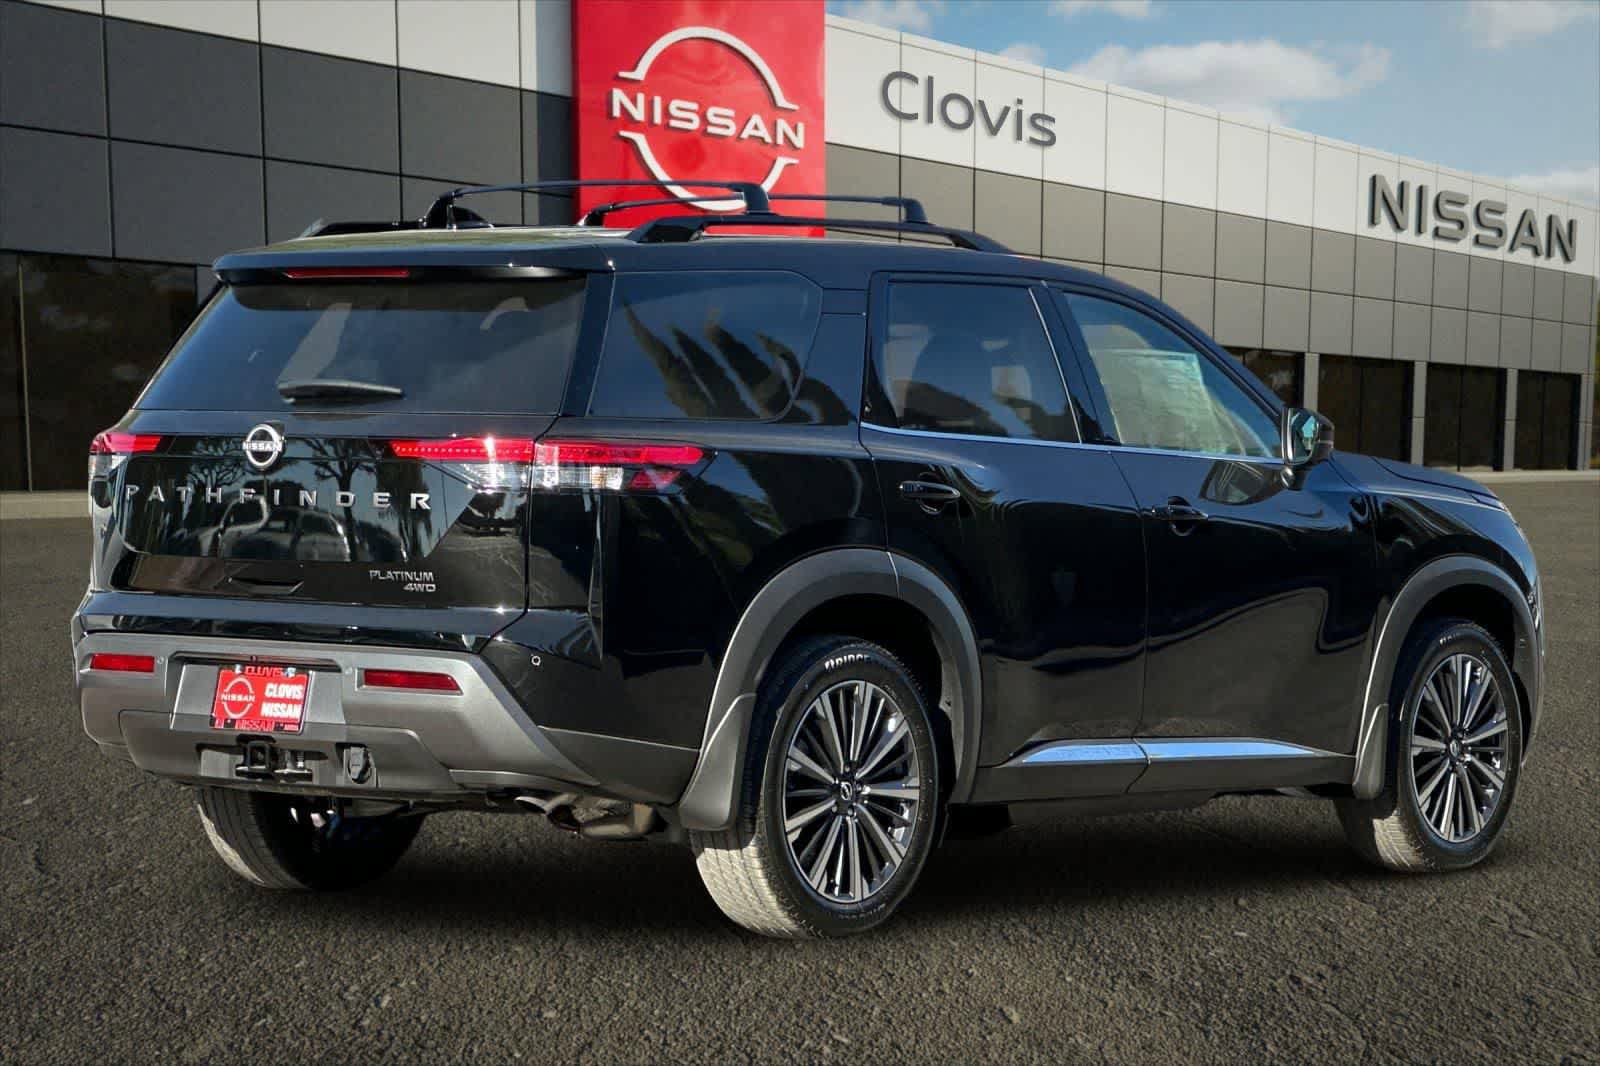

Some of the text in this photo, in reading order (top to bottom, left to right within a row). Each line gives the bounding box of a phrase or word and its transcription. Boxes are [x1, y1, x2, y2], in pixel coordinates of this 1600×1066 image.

[882, 70, 1057, 147] Clovis
[612, 87, 805, 149] NISSAN
[1369, 173, 1578, 263] NISSAN
[242, 441, 282, 451] NISSAN
[125, 485, 432, 510] PATHFINDER
[369, 569, 434, 582] PLATINUM
[403, 582, 437, 593] 4WD
[221, 693, 255, 702] NISSAN
[264, 683, 303, 699] CLOVIS
[261, 701, 303, 718] NISSAN
